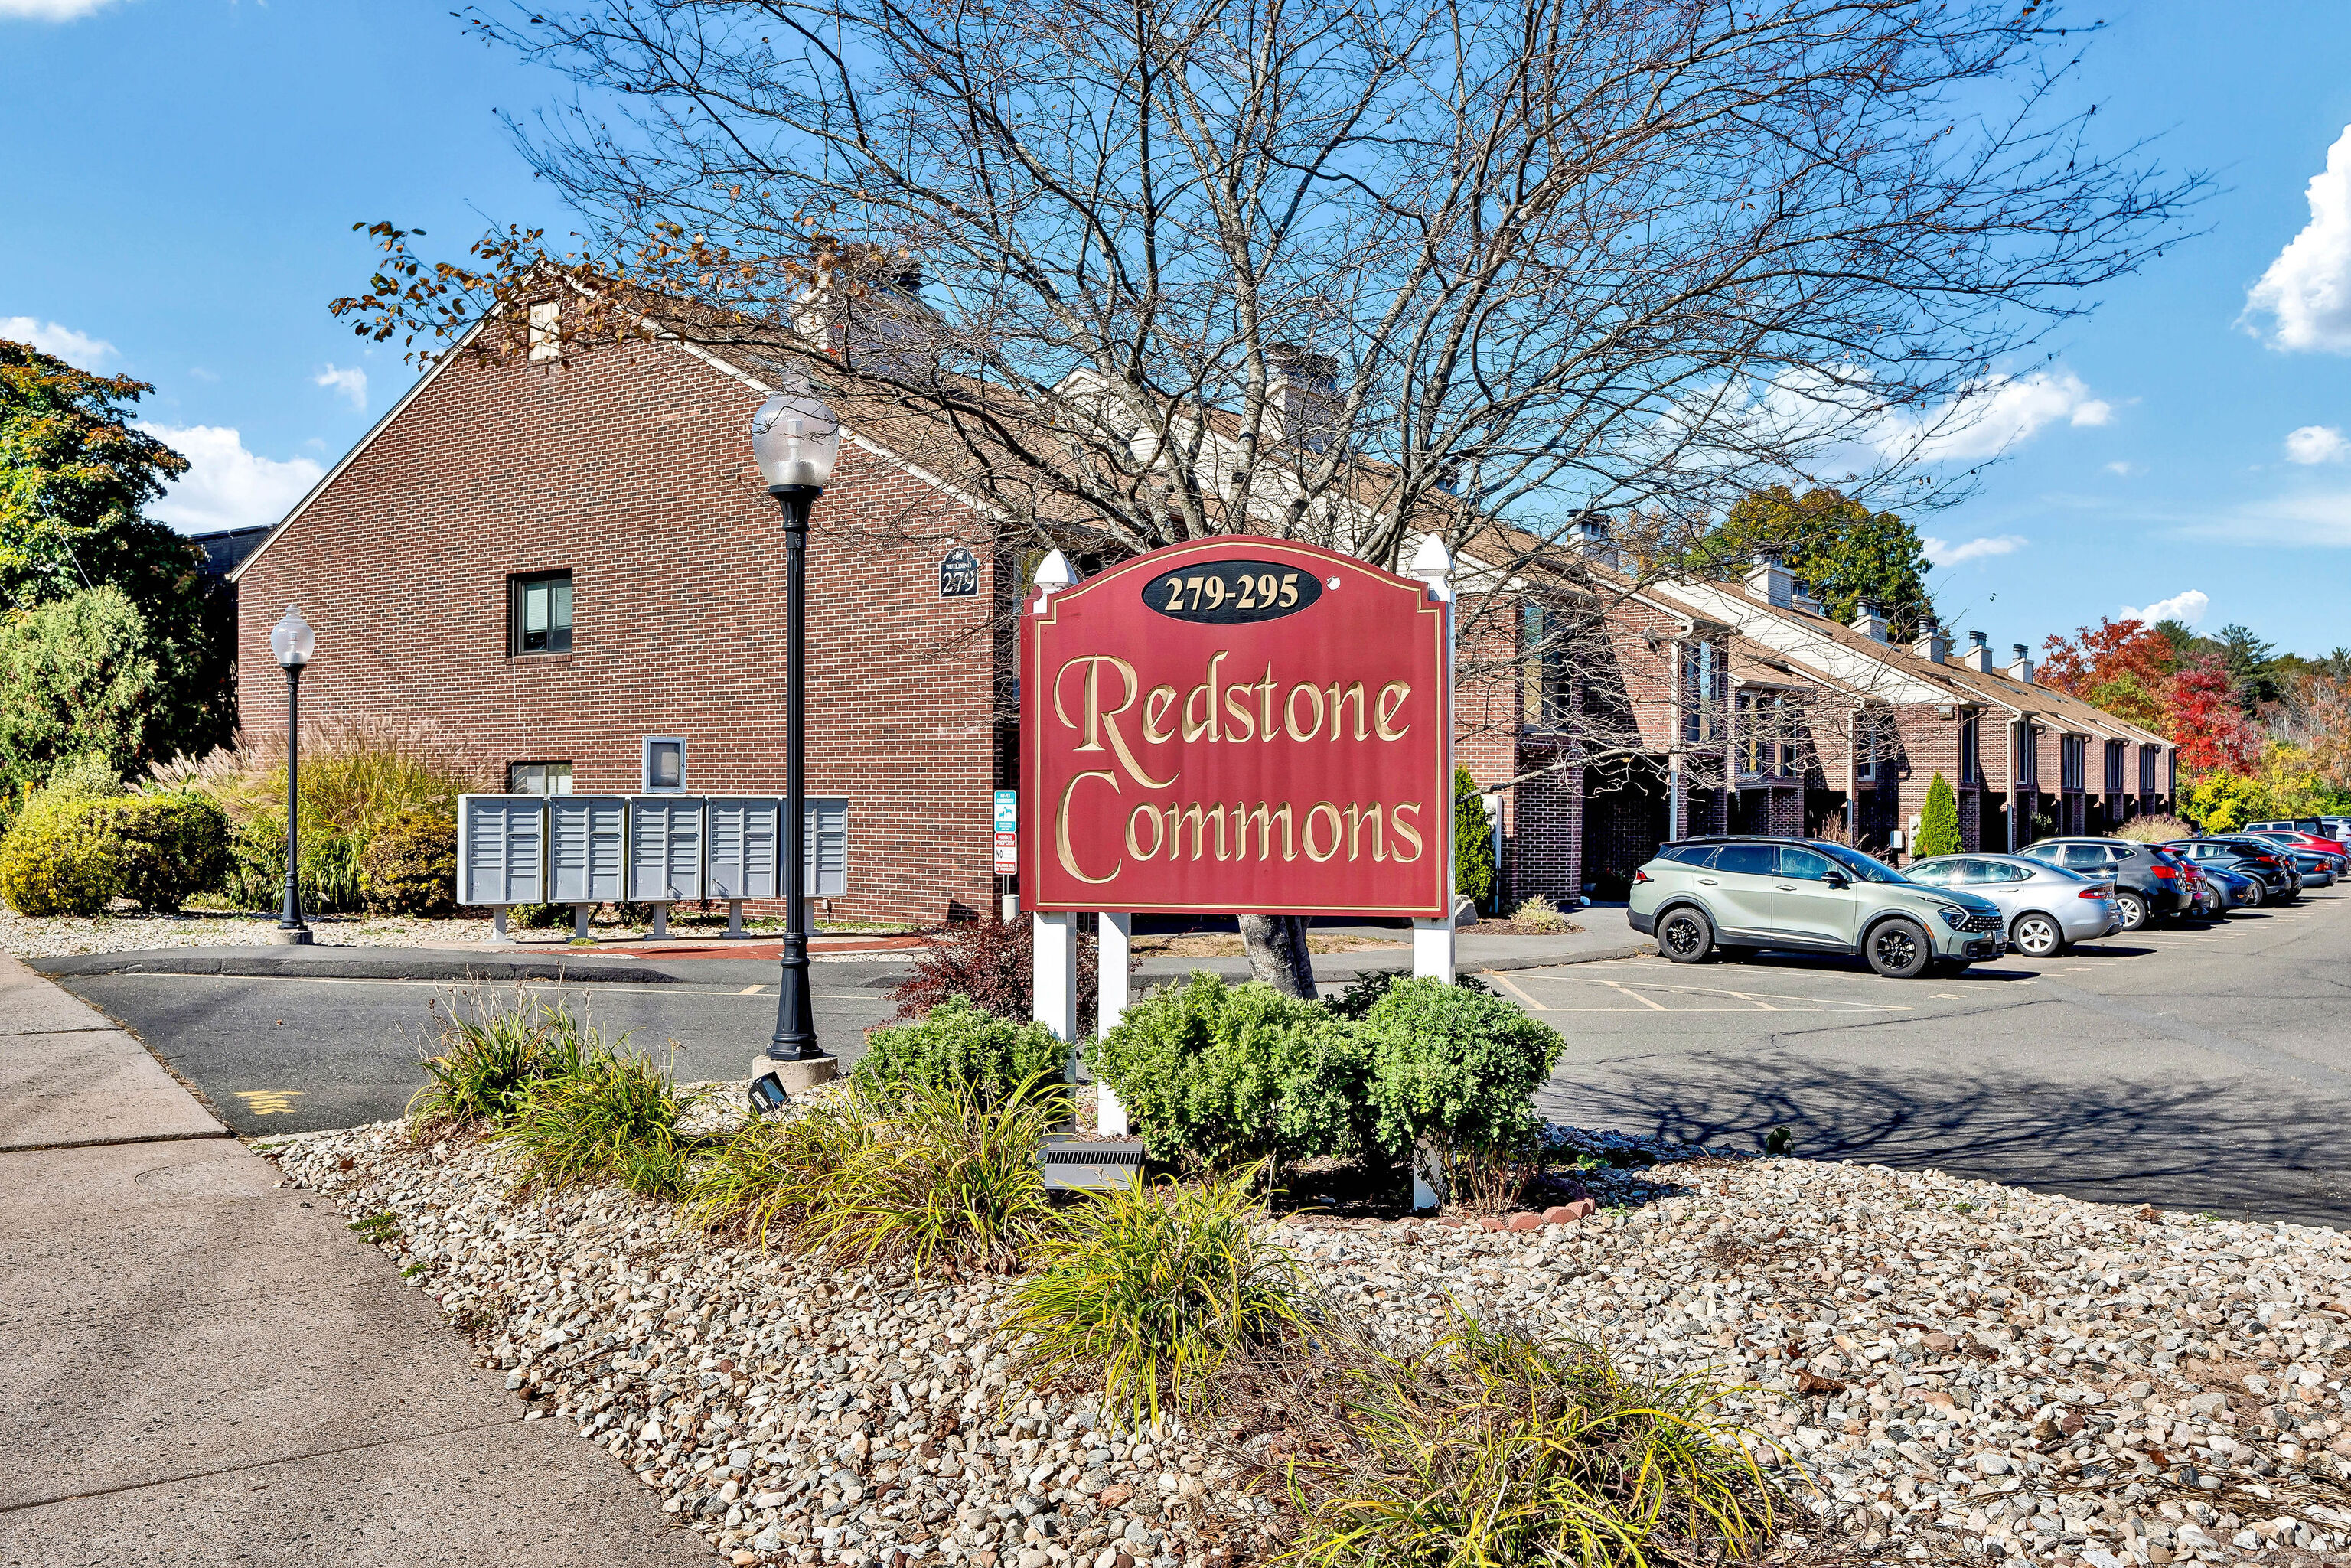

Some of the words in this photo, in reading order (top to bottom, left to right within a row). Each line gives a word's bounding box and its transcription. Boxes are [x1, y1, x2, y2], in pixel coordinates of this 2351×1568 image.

[942, 570, 975, 593] 279
[1165, 573, 1300, 611] 279-295
[1053, 650, 1412, 789] Redstone
[1055, 770, 1423, 884] Commons
[996, 849, 1003, 859] NO
